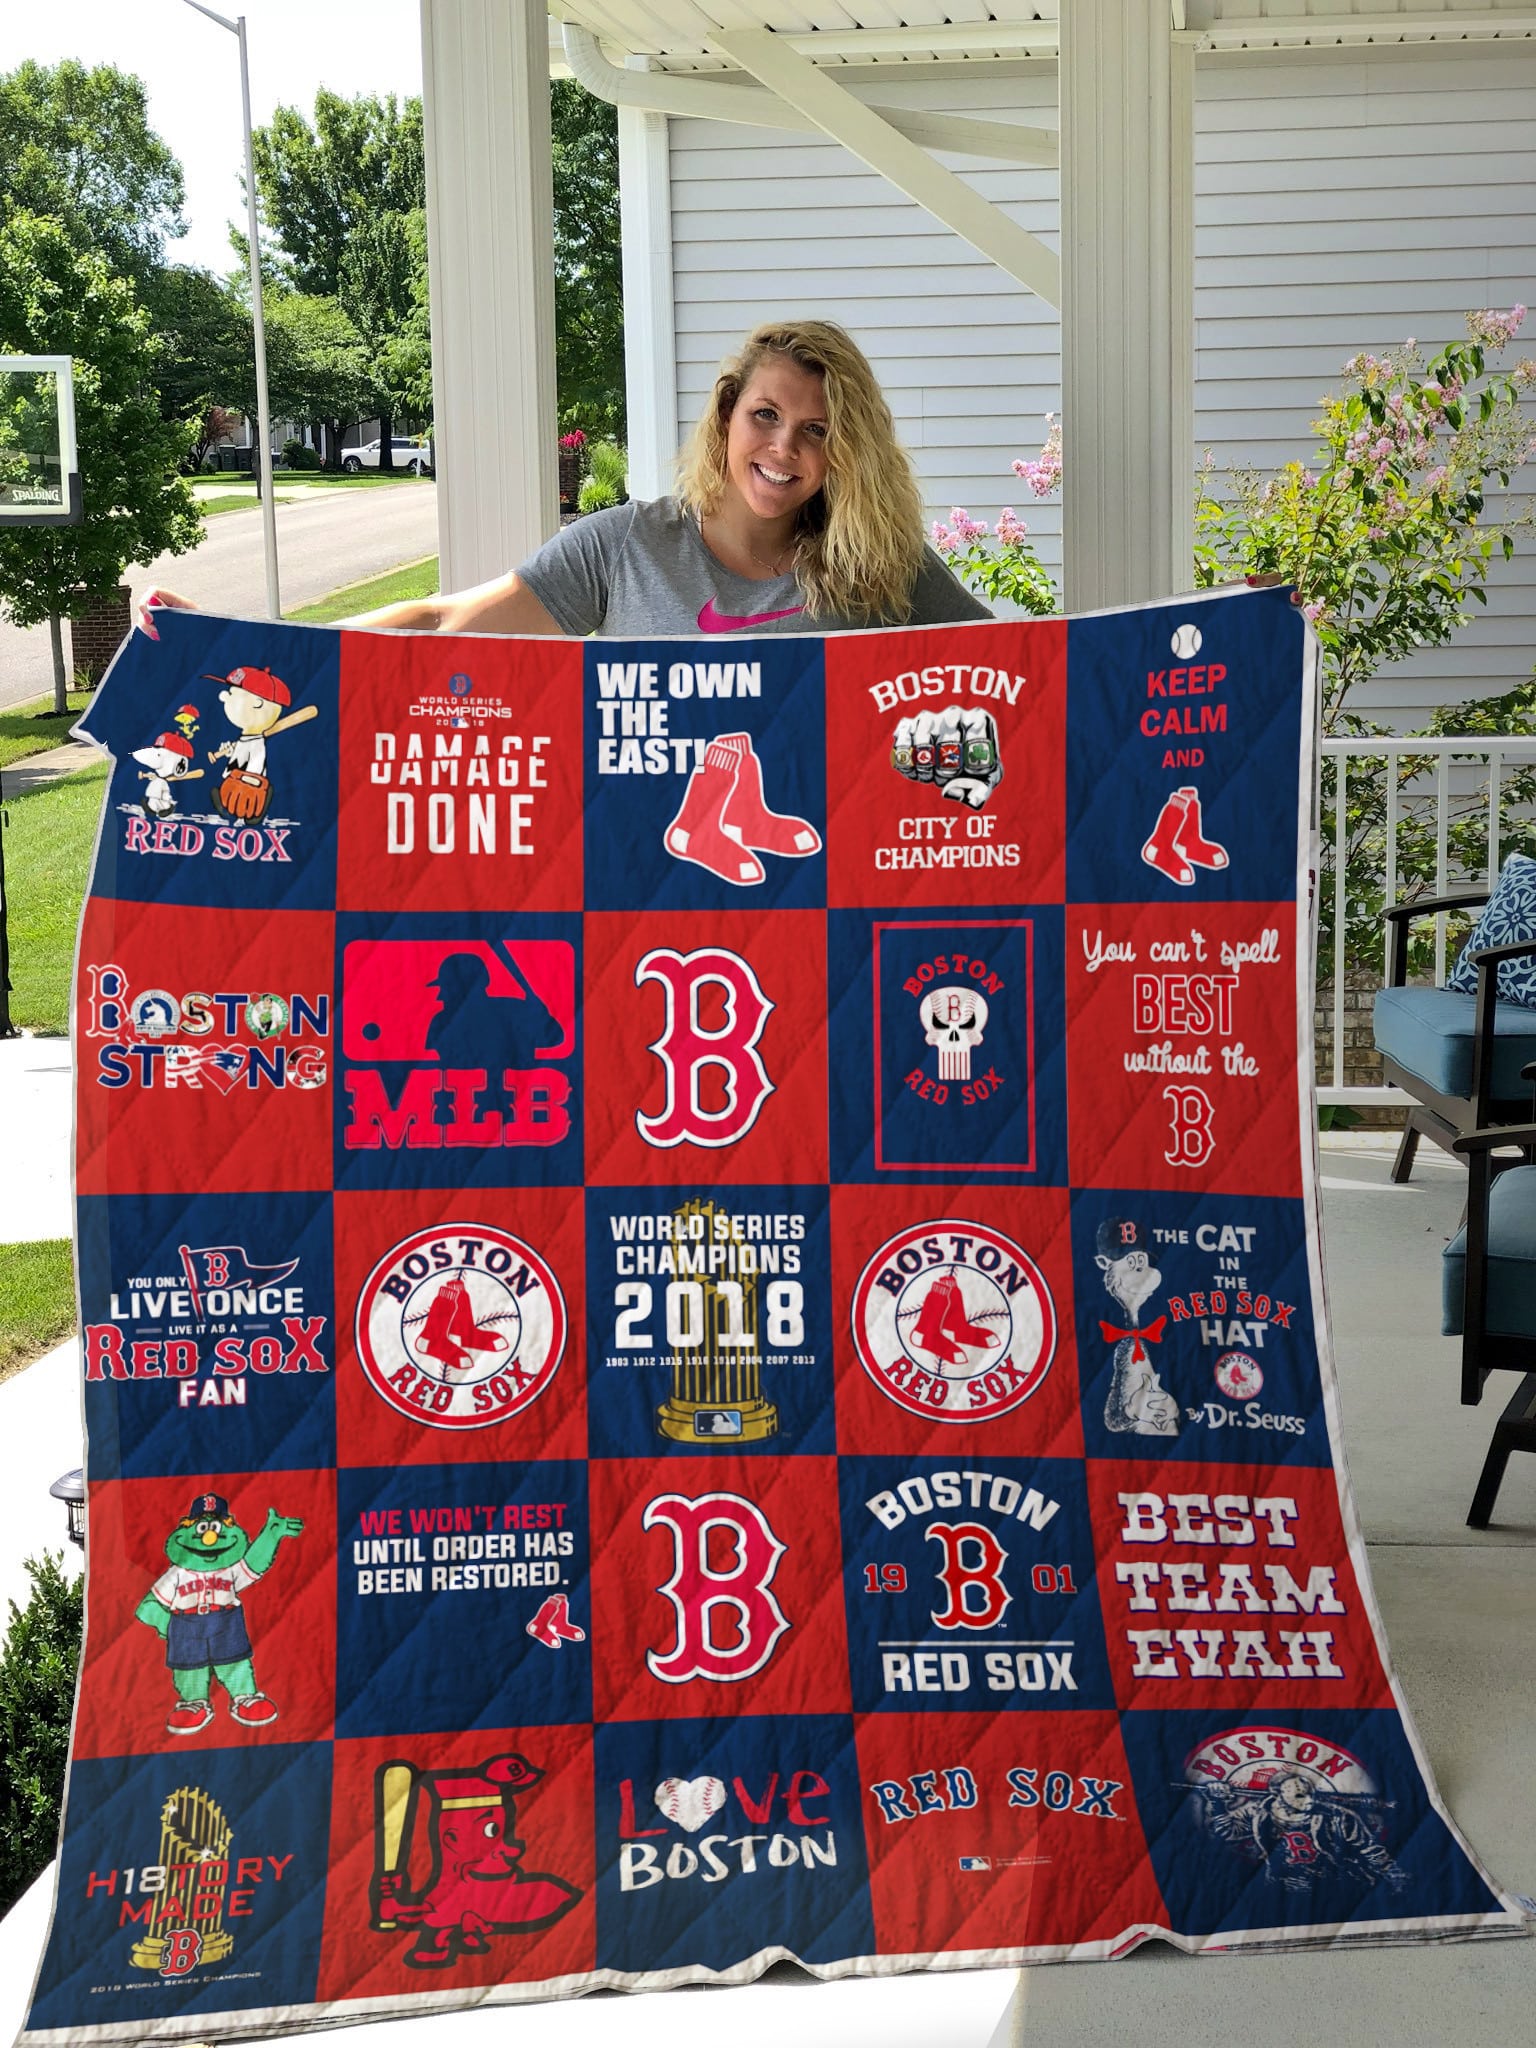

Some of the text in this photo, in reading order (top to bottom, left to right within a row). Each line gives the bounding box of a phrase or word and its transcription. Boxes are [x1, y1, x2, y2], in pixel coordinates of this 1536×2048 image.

[12, 489, 60, 501] SPALDING
[596, 662, 761, 699] WE OWN
[868, 664, 1026, 714] BOSTON
[1147, 664, 1228, 699] KEEP
[409, 704, 512, 718] CHAMPIONS
[419, 696, 502, 706] WORLD SERIES
[596, 701, 669, 736] THE
[1139, 704, 1228, 738] CALM
[370, 733, 552, 788] DAMAGE
[598, 738, 706, 775] EAST!
[1161, 749, 1205, 769] AND
[124, 817, 293, 862] RED SOX
[388, 793, 535, 855] DONE
[898, 814, 998, 840] CITY OF
[875, 843, 1021, 870] CHAMPIONS
[1082, 928, 1281, 973] You can't spell
[902, 953, 1005, 998] BOSTON
[948, 994, 962, 1023] B
[1133, 973, 1239, 1036] BEST
[634, 946, 777, 1148] B
[1123, 1040, 1260, 1077] without the
[903, 1066, 1006, 1106] RED SOX
[343, 1068, 573, 1150] MLB
[1163, 1085, 1216, 1168] B
[610, 1214, 806, 1241] WORLD SERIES
[1119, 1221, 1137, 1244] B
[1153, 1224, 1256, 1253] THE CAT
[203, 1251, 230, 1287] B
[380, 1239, 540, 1304] BOSTON
[616, 1244, 801, 1276] CHAMPIONS
[875, 1236, 1029, 1297] BOSTON
[1219, 1257, 1240, 1270] IN
[127, 1276, 187, 1289] YOU ONLY
[1213, 1275, 1247, 1290] THE
[110, 1287, 304, 1320] LIVE ONCE
[614, 1280, 804, 1349] 2018
[1168, 1290, 1296, 1329] RED SOX
[169, 1324, 238, 1336] LIVE IT AS A
[1200, 1320, 1268, 1348] HAT
[84, 1323, 202, 1381] RED
[633, 1357, 655, 1366] 1912
[659, 1357, 682, 1366] 1915
[740, 1356, 763, 1365] 2004
[766, 1355, 789, 1365] 2007
[792, 1355, 815, 1365] 2013
[1219, 1355, 1256, 1370] BOSTON
[179, 1378, 247, 1407] FAN
[388, 1357, 539, 1414] RED SOX
[884, 1353, 1030, 1408] RED SOX
[1185, 1402, 1306, 1436] By Dr. Seuss
[360, 1503, 568, 1536] WE WON'T REST
[865, 1471, 1061, 1532] BOSTON
[1117, 1491, 1299, 1548] BEST
[353, 1531, 574, 1565] UNTIL ORDER HAS
[357, 1561, 569, 1595] BEEN RESTORED.
[641, 1491, 793, 1685] B
[864, 1563, 1077, 1594] 19 01
[924, 1521, 1014, 1632] B
[1115, 1561, 1347, 1616] TEAM
[1126, 1628, 1345, 1679] EVAH
[881, 1652, 1079, 1693] RED SOX
[508, 1763, 522, 1777] B
[1193, 1734, 1353, 1780] BOSTON
[870, 1766, 1124, 1825] RED SOX
[619, 1830, 838, 1892] BOSTON
[1279, 1831, 1318, 1864] B
[86, 1853, 295, 1898] H18TORY
[118, 1889, 256, 1927] MADE
[159, 1928, 202, 1977] B
[90, 1985, 121, 1994] 2018
